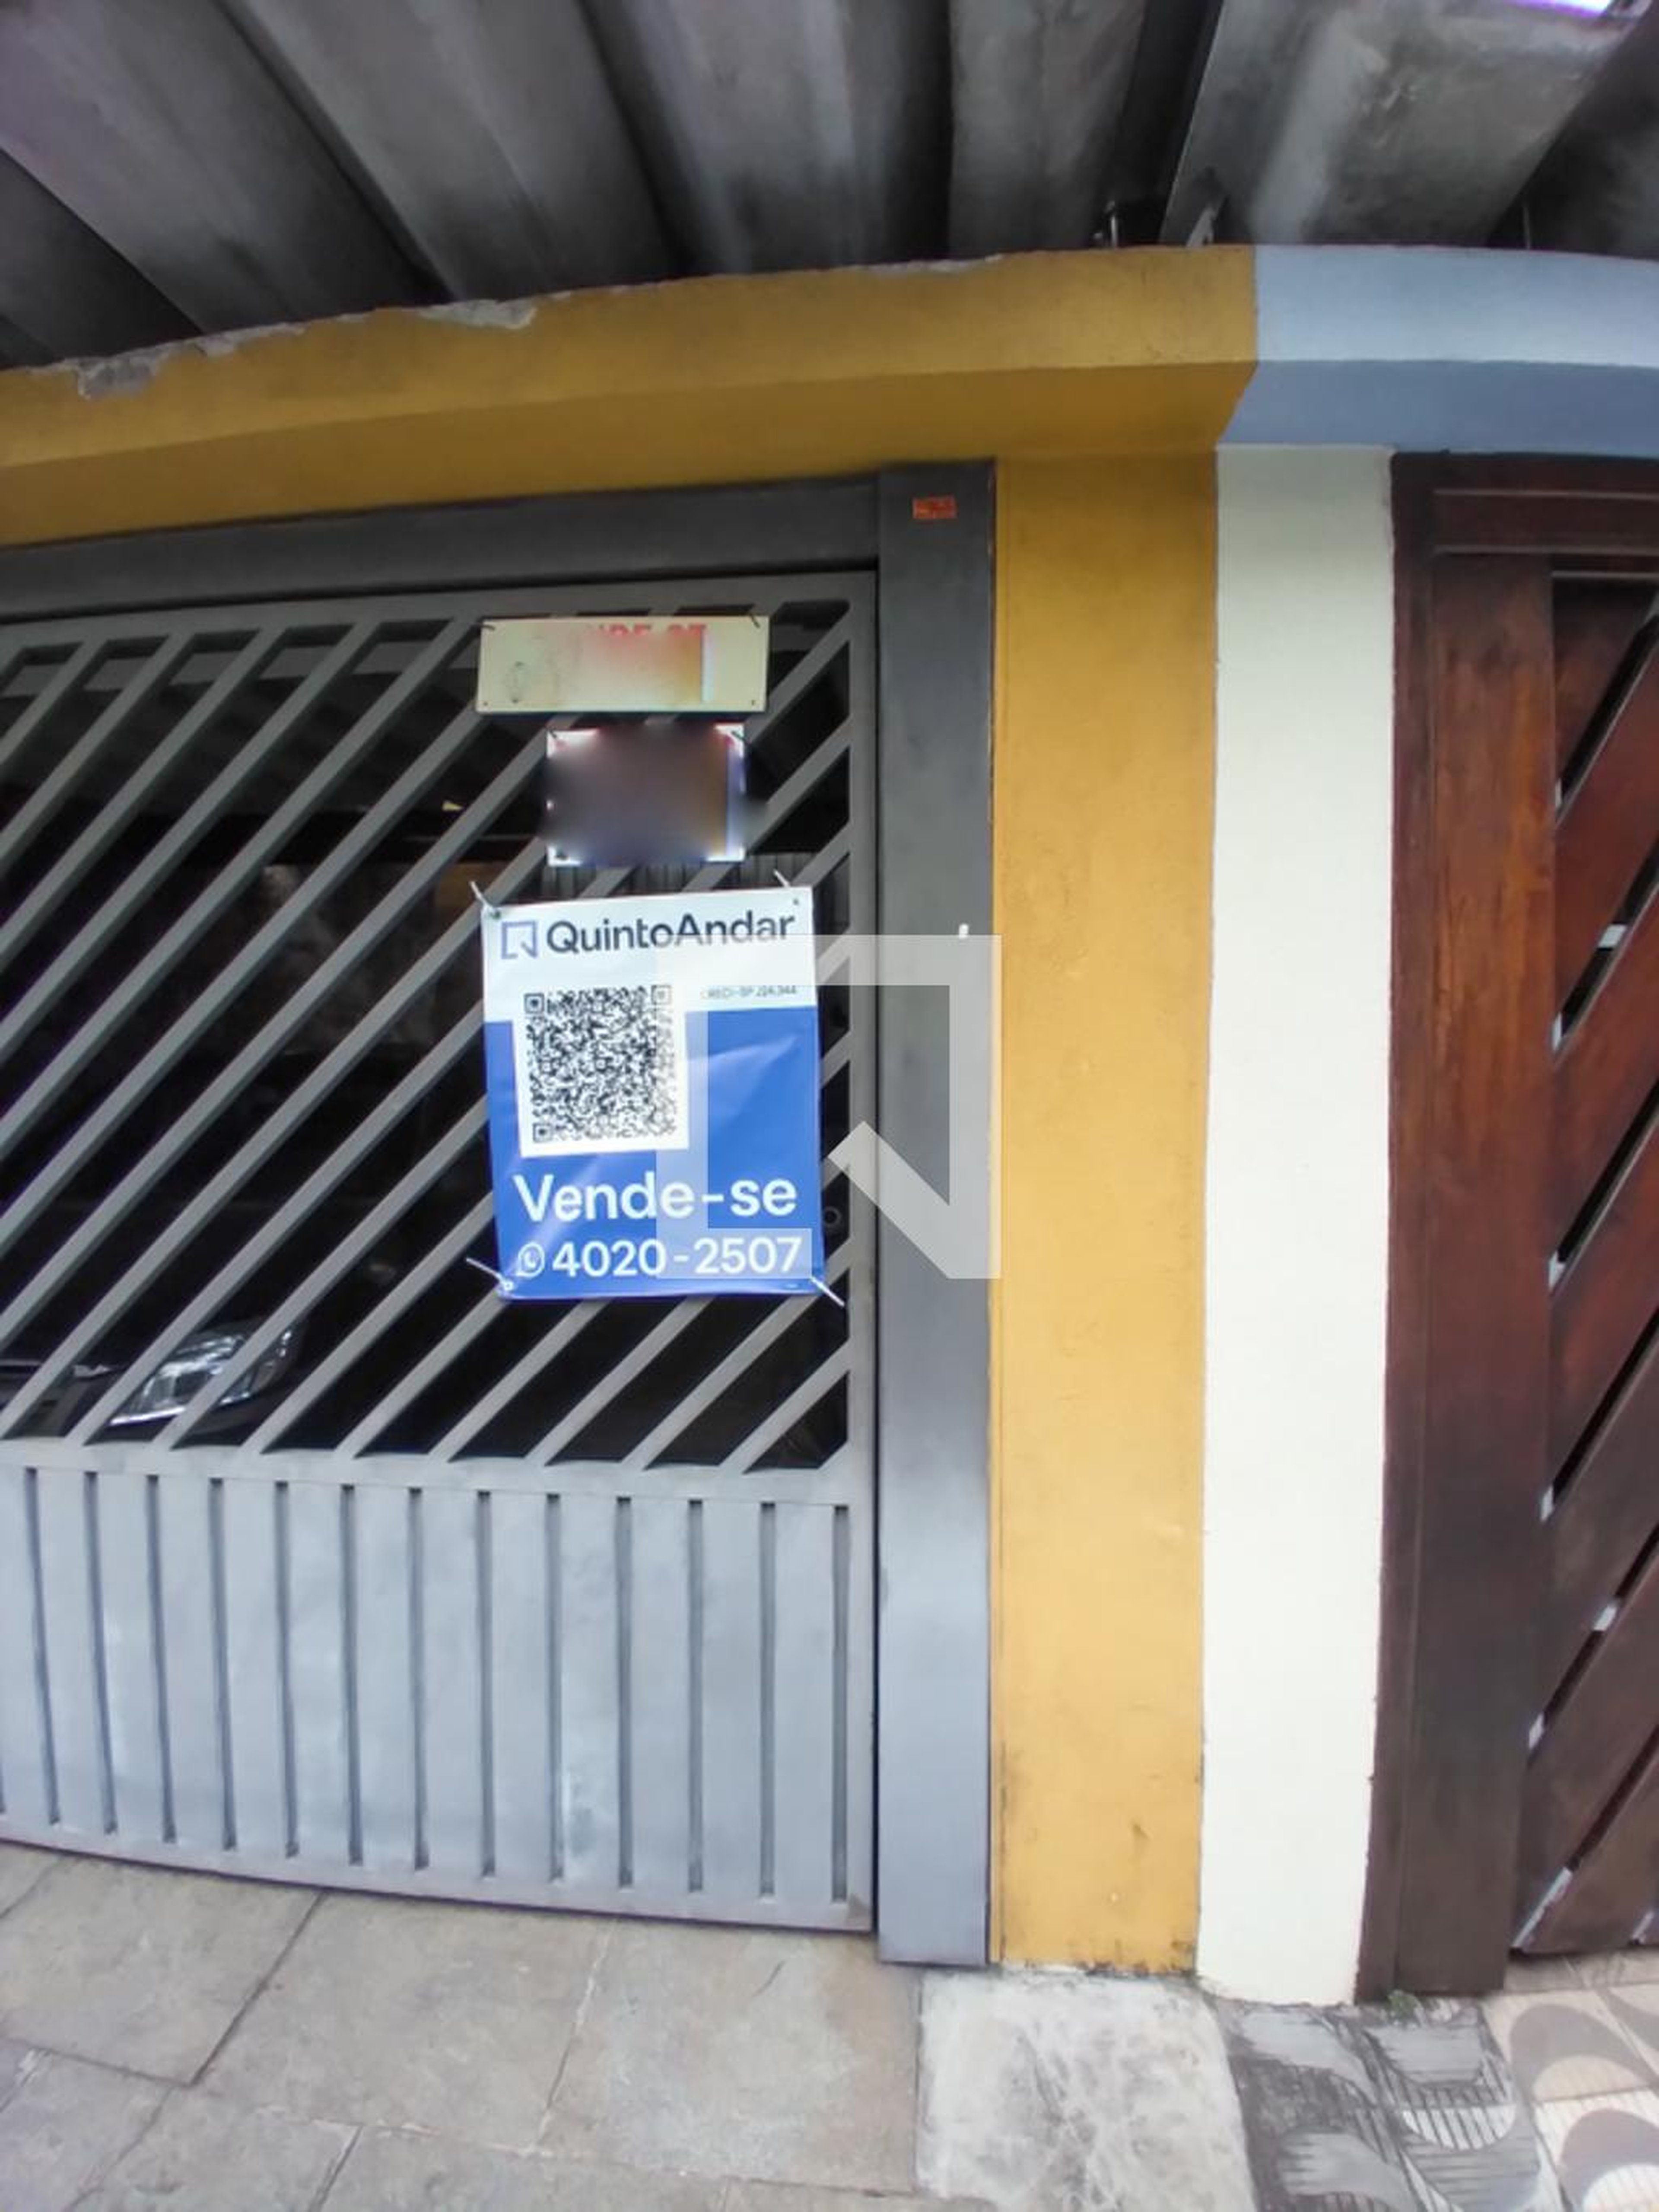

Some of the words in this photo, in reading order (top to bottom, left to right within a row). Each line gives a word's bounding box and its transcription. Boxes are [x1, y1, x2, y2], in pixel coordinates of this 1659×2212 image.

[547, 911, 795, 954] QuintoAndar
[513, 1171, 797, 1222] Vende-se
[553, 1236, 802, 1278] 4020-2507
